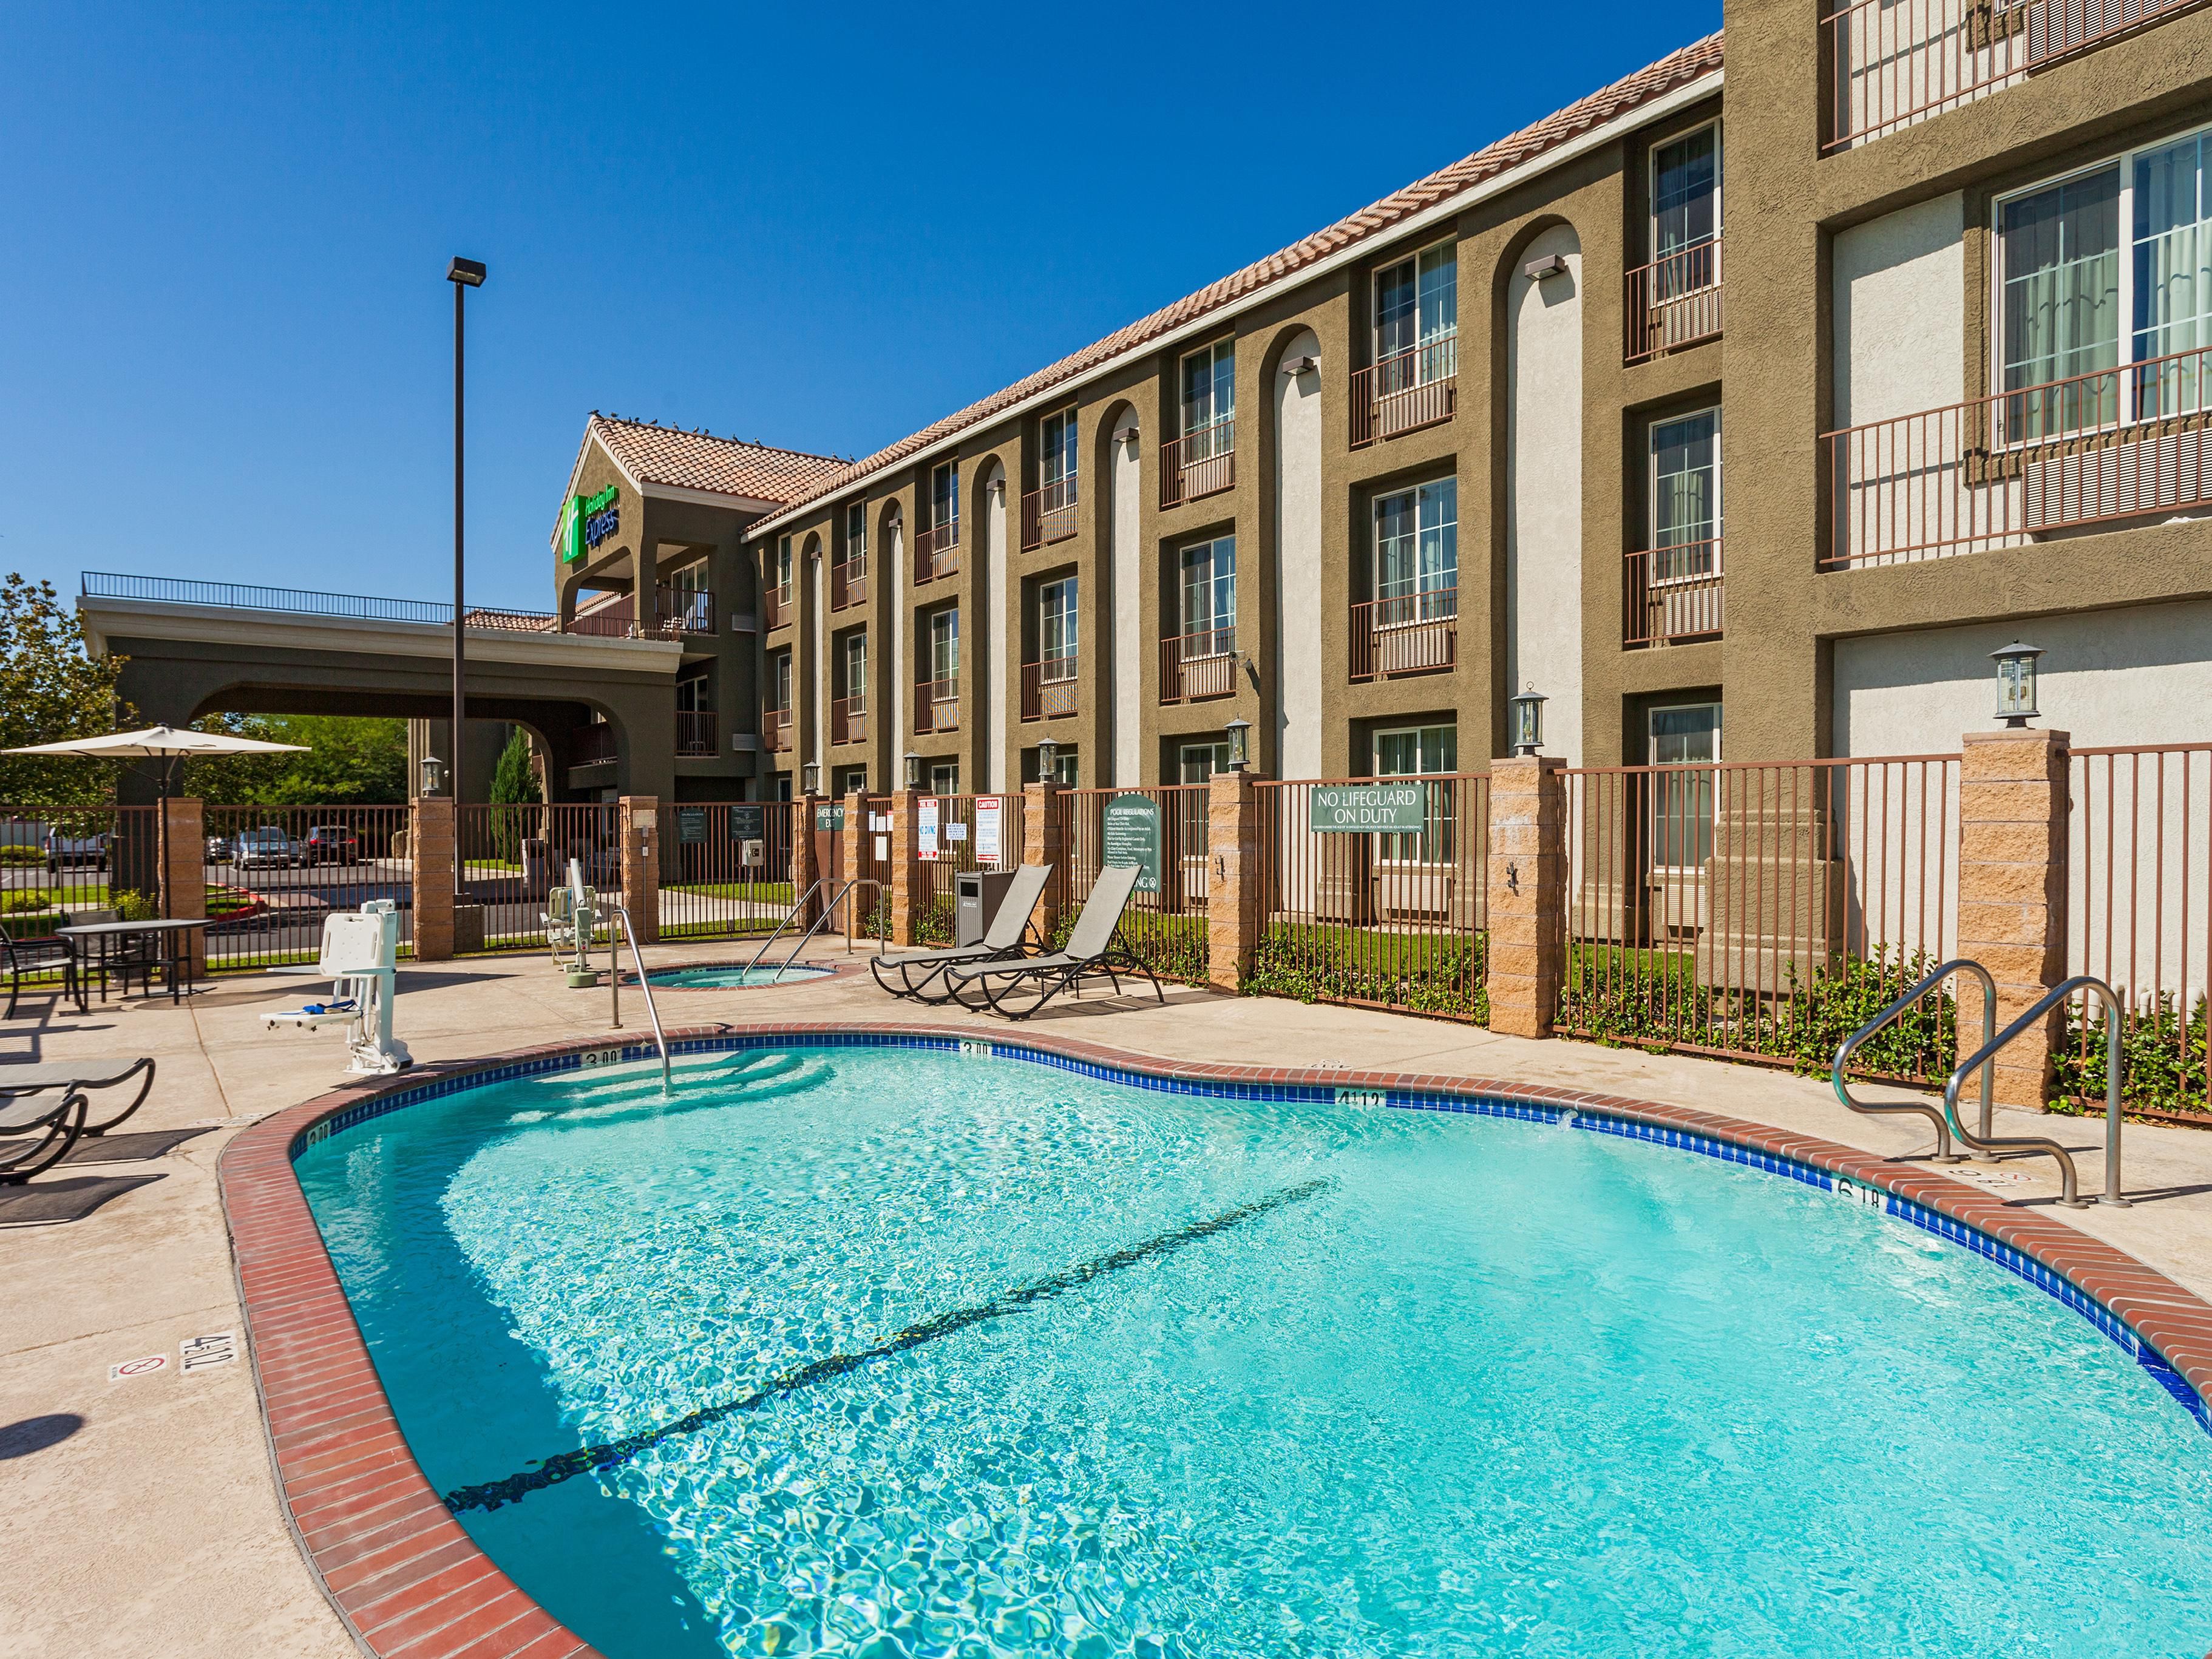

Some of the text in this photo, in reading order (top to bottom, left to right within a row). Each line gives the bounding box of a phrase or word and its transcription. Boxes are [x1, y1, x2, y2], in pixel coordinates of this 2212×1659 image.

[585, 484, 614, 517] Holiday Inn
[585, 509, 619, 547] Express
[1318, 790, 1416, 807] NO LIFEGUARD
[826, 819, 835, 827] EXT
[1335, 809, 1397, 823] ON DUTY
